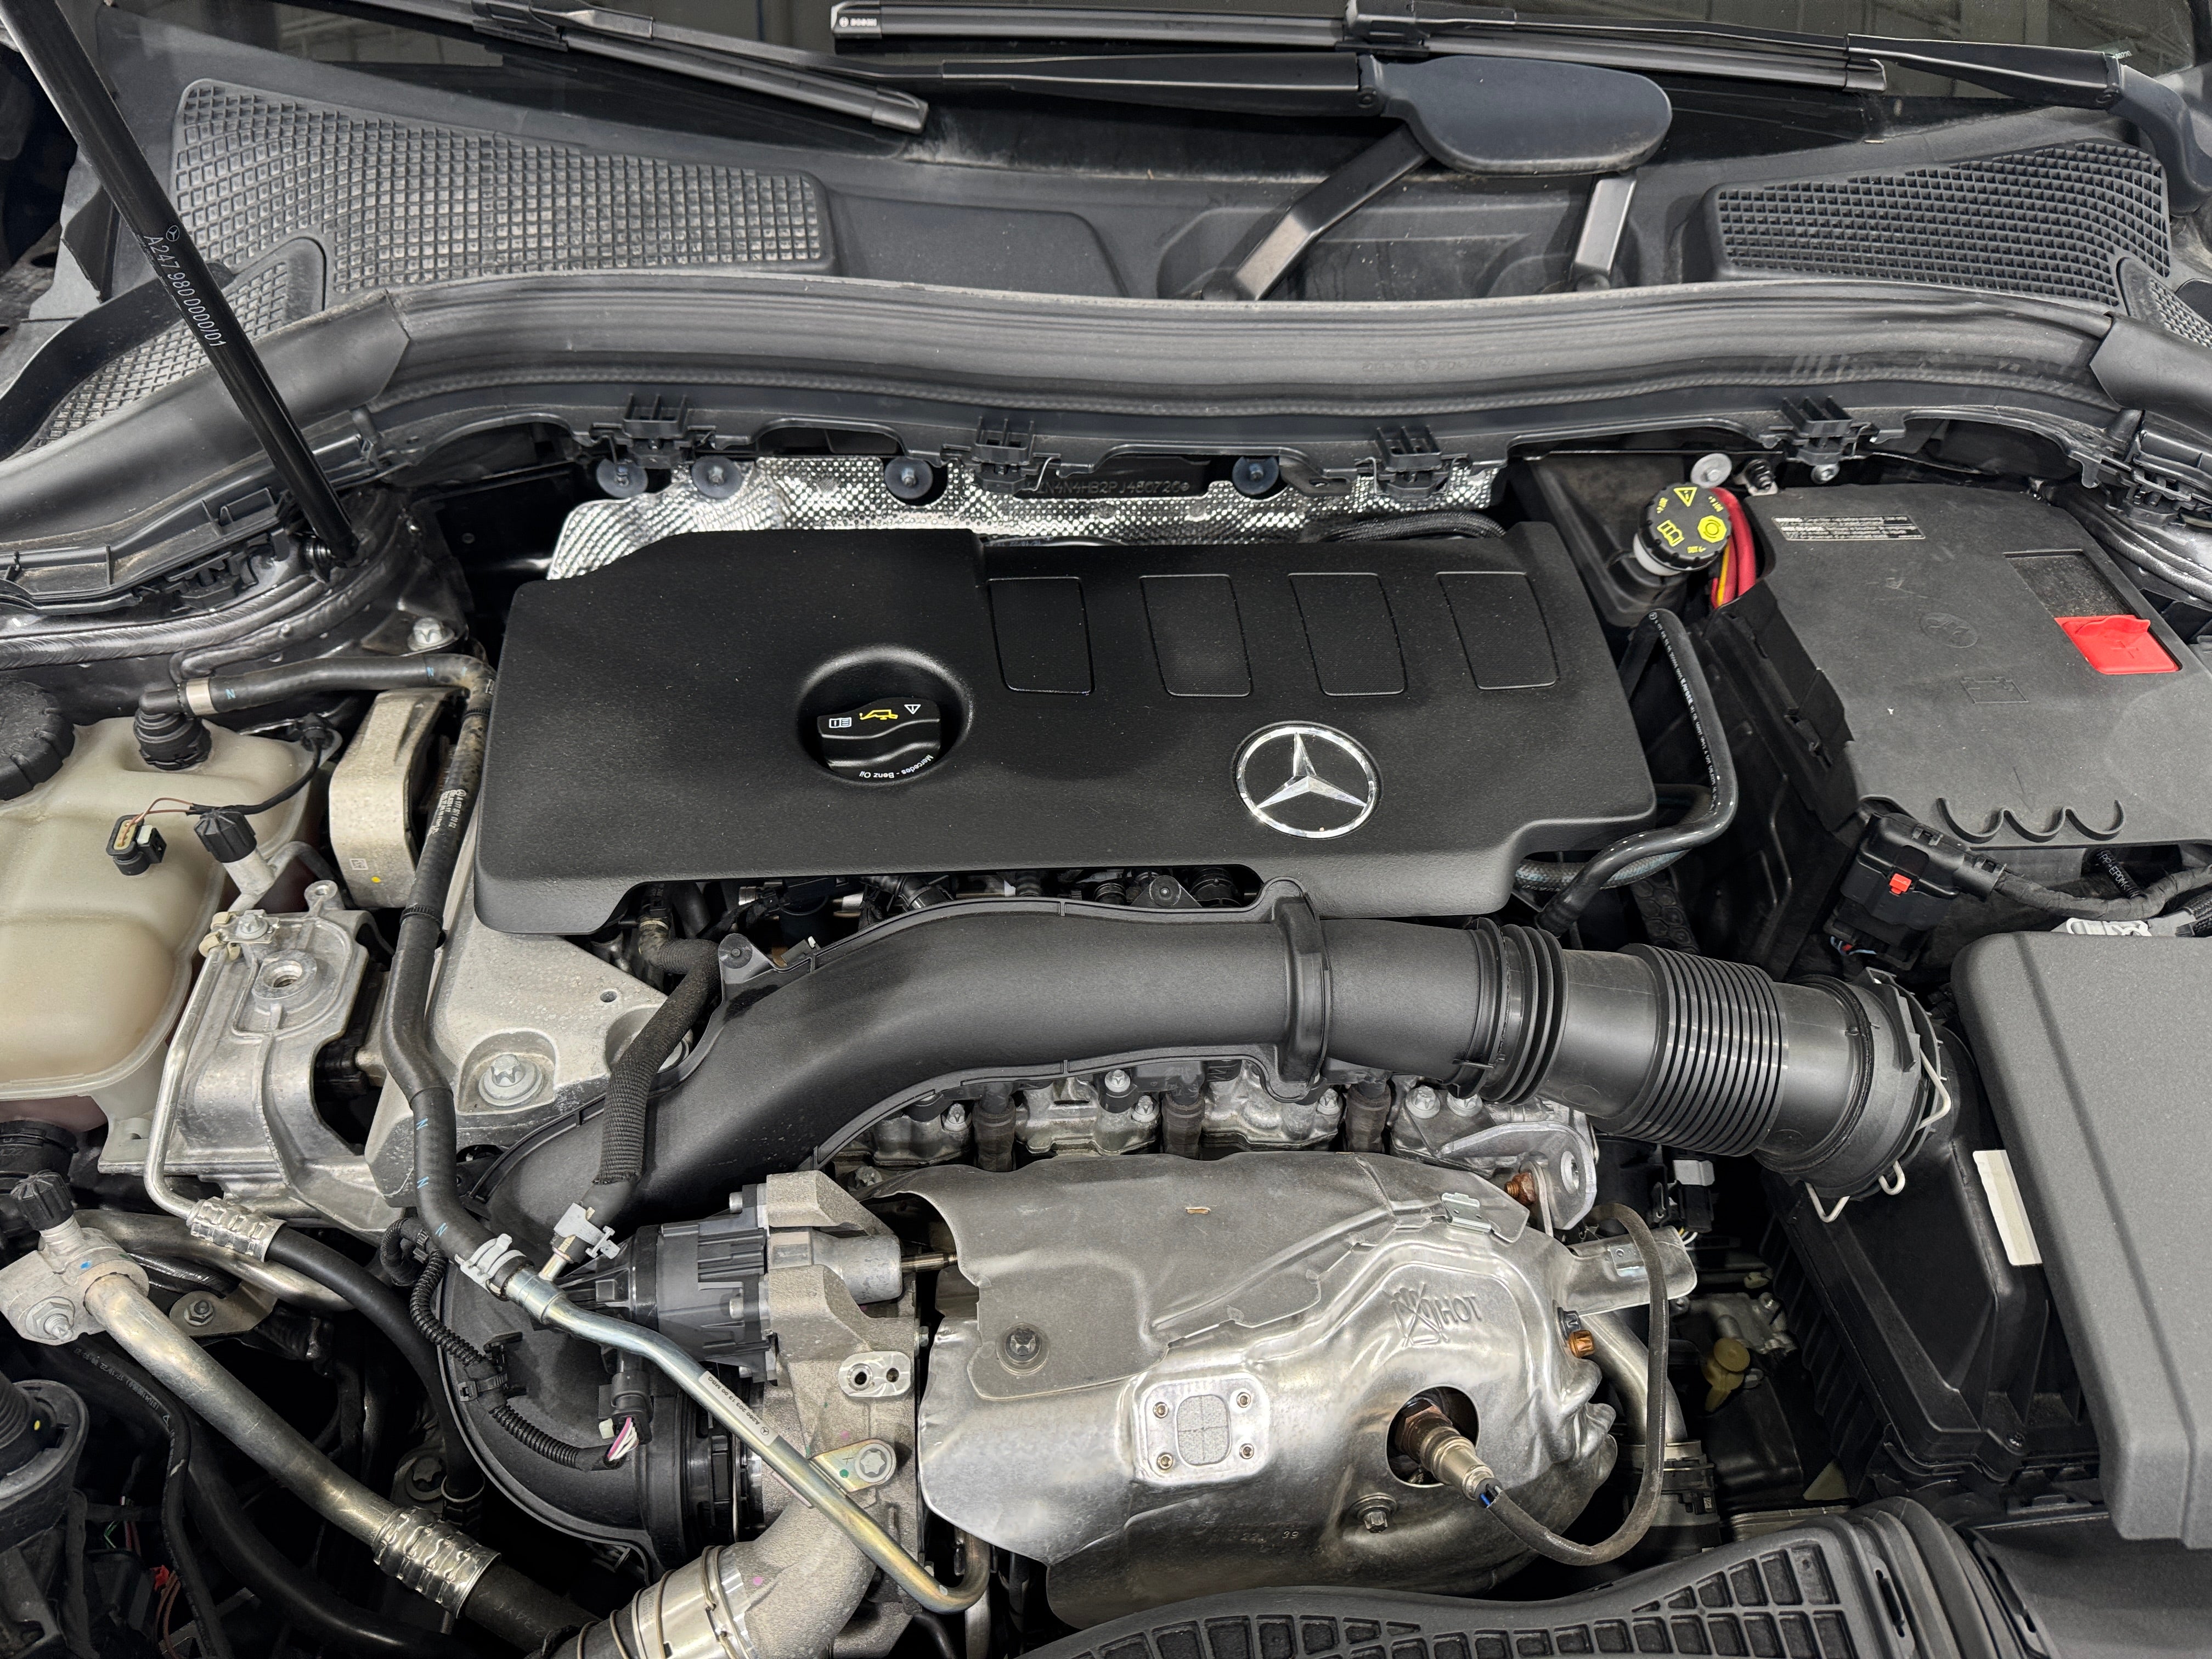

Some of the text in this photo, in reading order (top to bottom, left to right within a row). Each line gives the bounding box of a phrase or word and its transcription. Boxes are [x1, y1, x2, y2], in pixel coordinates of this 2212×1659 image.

[143, 235, 227, 347] A247 980 0000/01
[901, 754, 934, 775] Mercedes
[1435, 1294, 1482, 1324] HOT
[736, 1402, 747, 1412] 203
